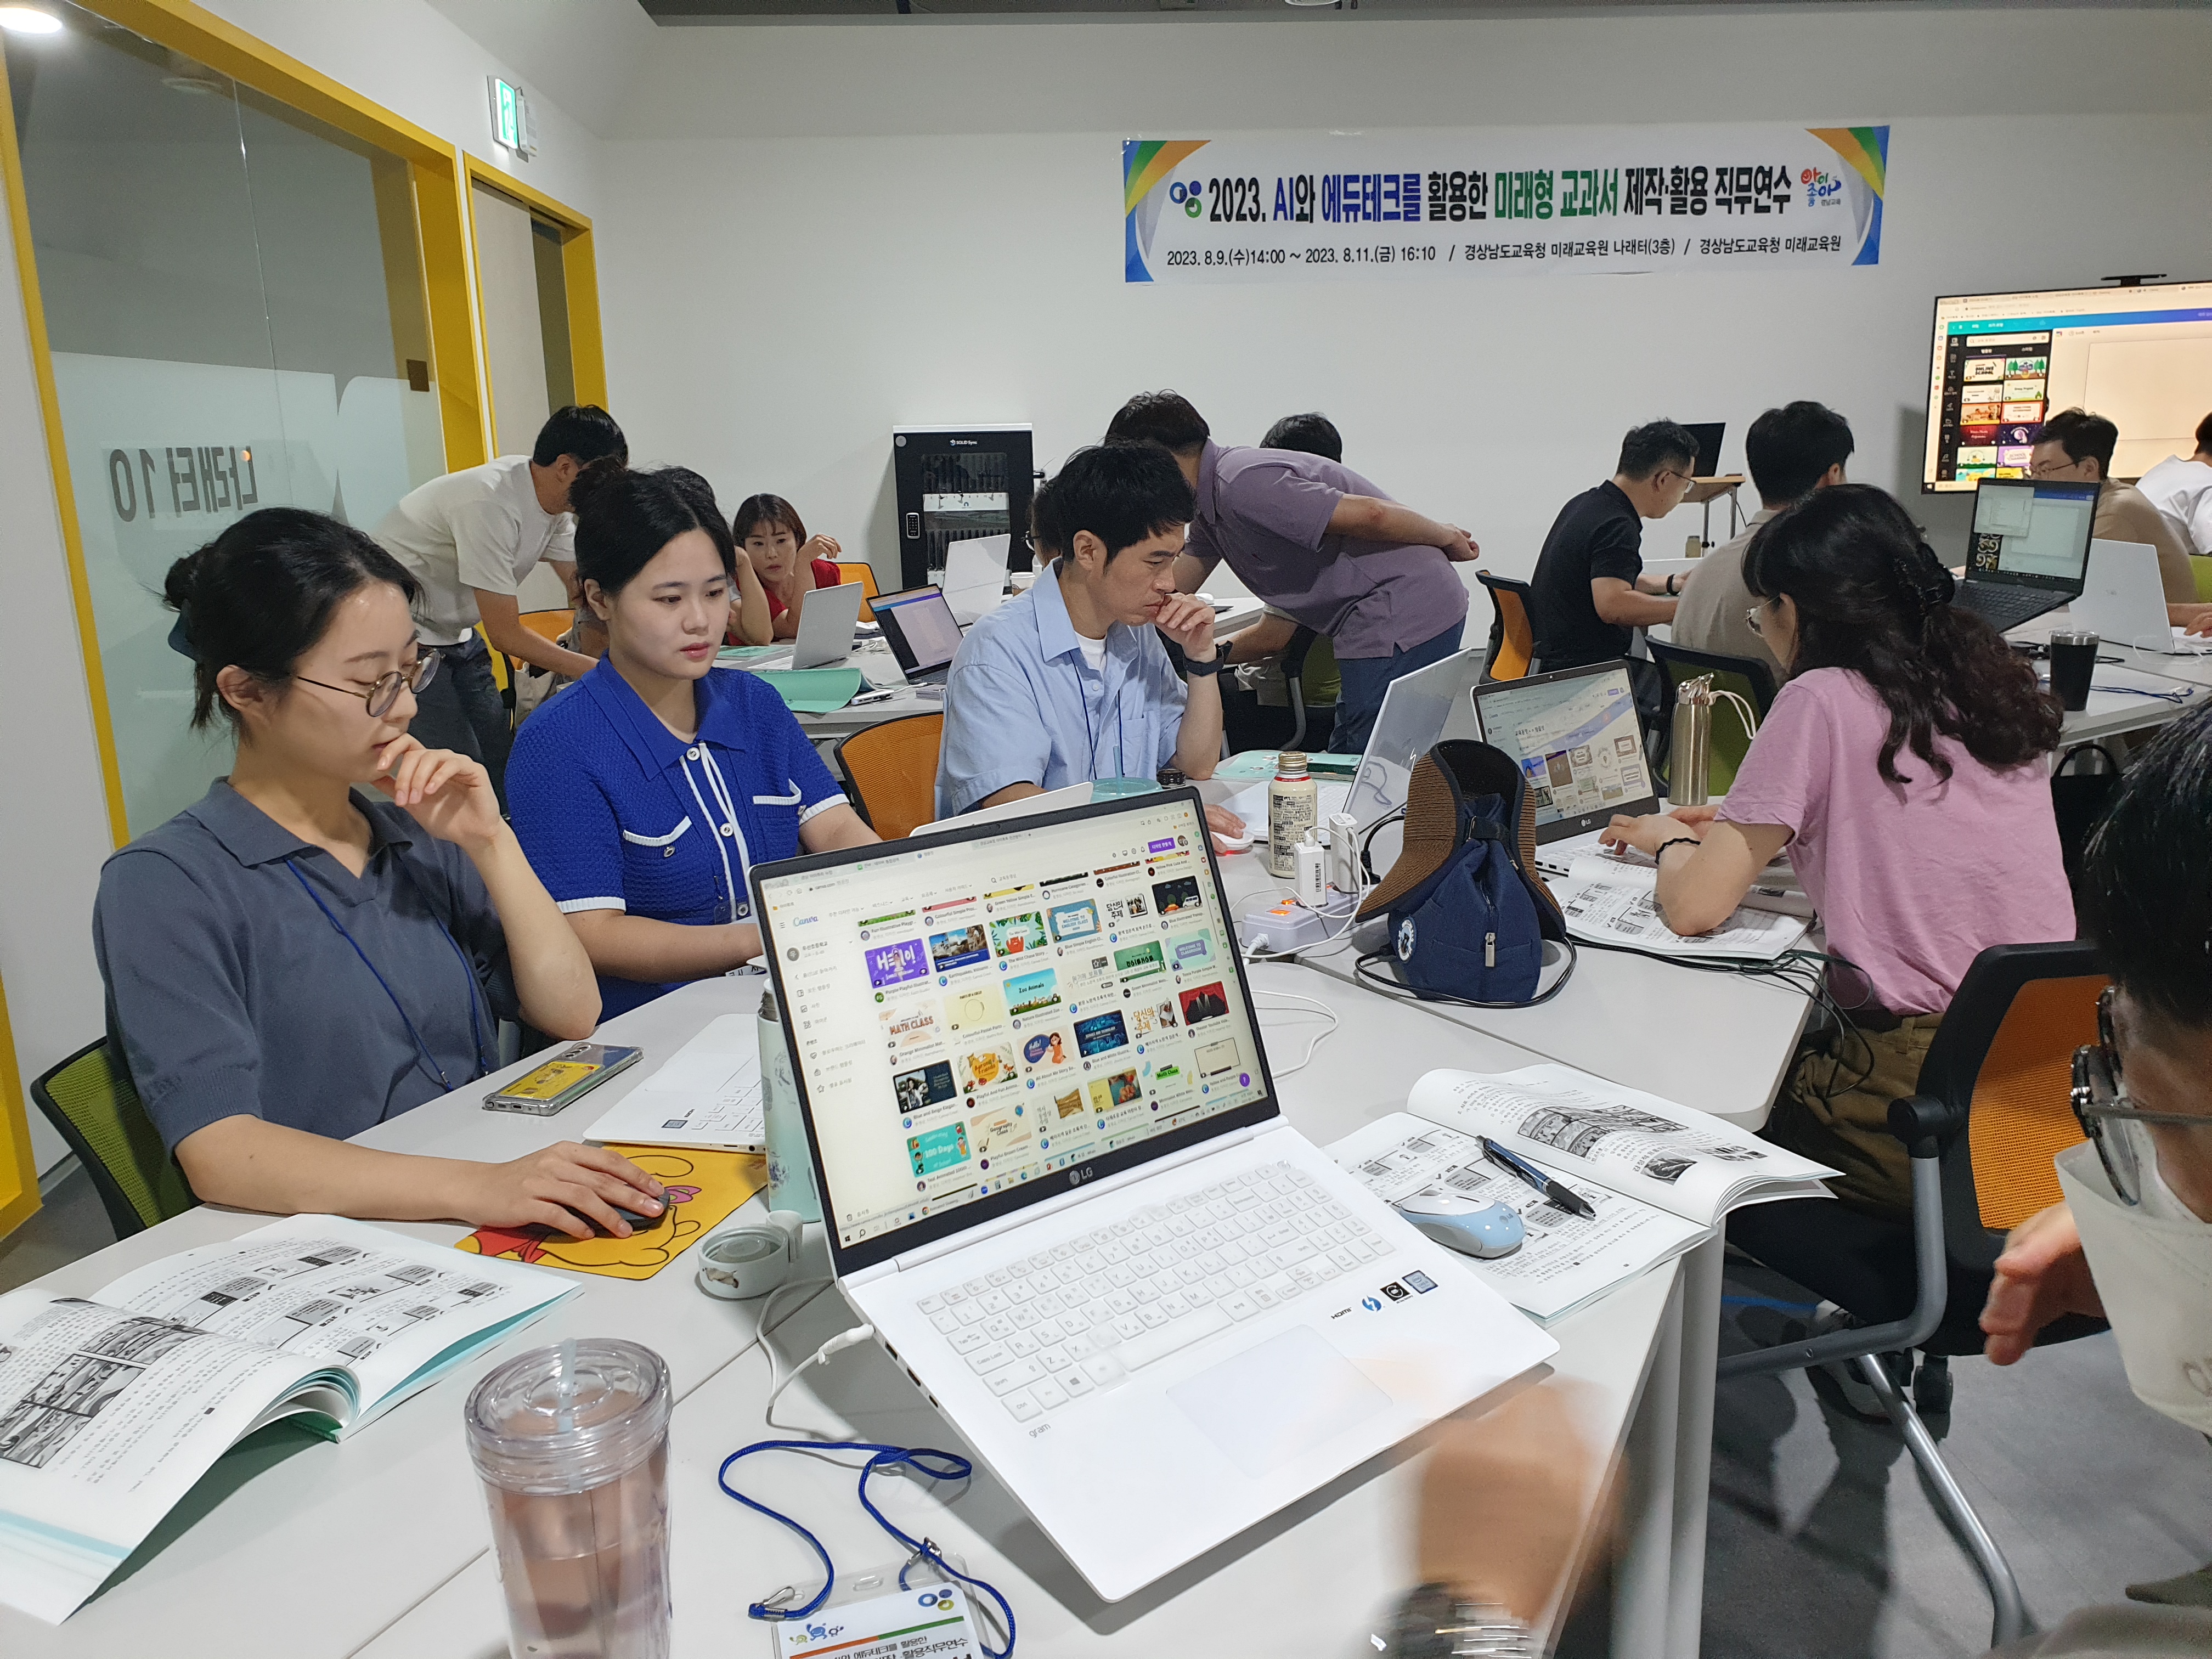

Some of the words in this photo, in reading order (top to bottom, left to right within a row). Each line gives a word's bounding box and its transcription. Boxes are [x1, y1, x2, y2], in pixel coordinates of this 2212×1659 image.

[1209, 178, 1266, 223] 2023.
[1273, 174, 1315, 223] AI와
[1322, 173, 1421, 223] 에듀테크를
[1428, 171, 1488, 221] 활용한
[1495, 169, 1553, 219] 미래형
[1561, 168, 1618, 217] 교과서
[1624, 165, 1708, 216] 제작·활용
[1715, 165, 1791, 215] 직무연수
[1167, 251, 1200, 266] 2023.
[1205, 249, 1285, 267] 8.9.(수)14:00
[1306, 249, 1339, 264] 2023.
[1344, 246, 1396, 264] 8.11.(금)
[1402, 246, 1436, 262] 16:10
[1449, 245, 1455, 262] /
[1465, 242, 1546, 261] 경상남도교육청
[1551, 239, 1609, 257] 미래교육원
[1613, 238, 1675, 256] 나래터(3층)
[1683, 239, 1691, 255] /
[1700, 237, 1780, 255] 경상남도교육청
[1785, 235, 1841, 252] 미래교육원
[1106, 900, 1124, 911] 당신의
[792, 913, 819, 927] Canva
[1110, 909, 1124, 919] 주제
[1178, 944, 1195, 952] WELCOME
[1028, 981, 1045, 991] Animals
[1132, 1006, 1155, 1023] 당신의
[889, 1022, 910, 1035] MATH
[910, 1015, 934, 1030] CLASS
[1136, 1019, 1152, 1034] 주제
[1156, 1070, 1167, 1079] Math
[1167, 1067, 1178, 1075] Class
[989, 1121, 1013, 1133] Geography
[996, 1128, 1008, 1136] Class
[924, 1147, 938, 1159] 100
[937, 1142, 955, 1155] Days
[1081, 1167, 1093, 1180] LG
[1330, 1307, 1351, 1319] HDMI
[1029, 1424, 1051, 1438] gram
